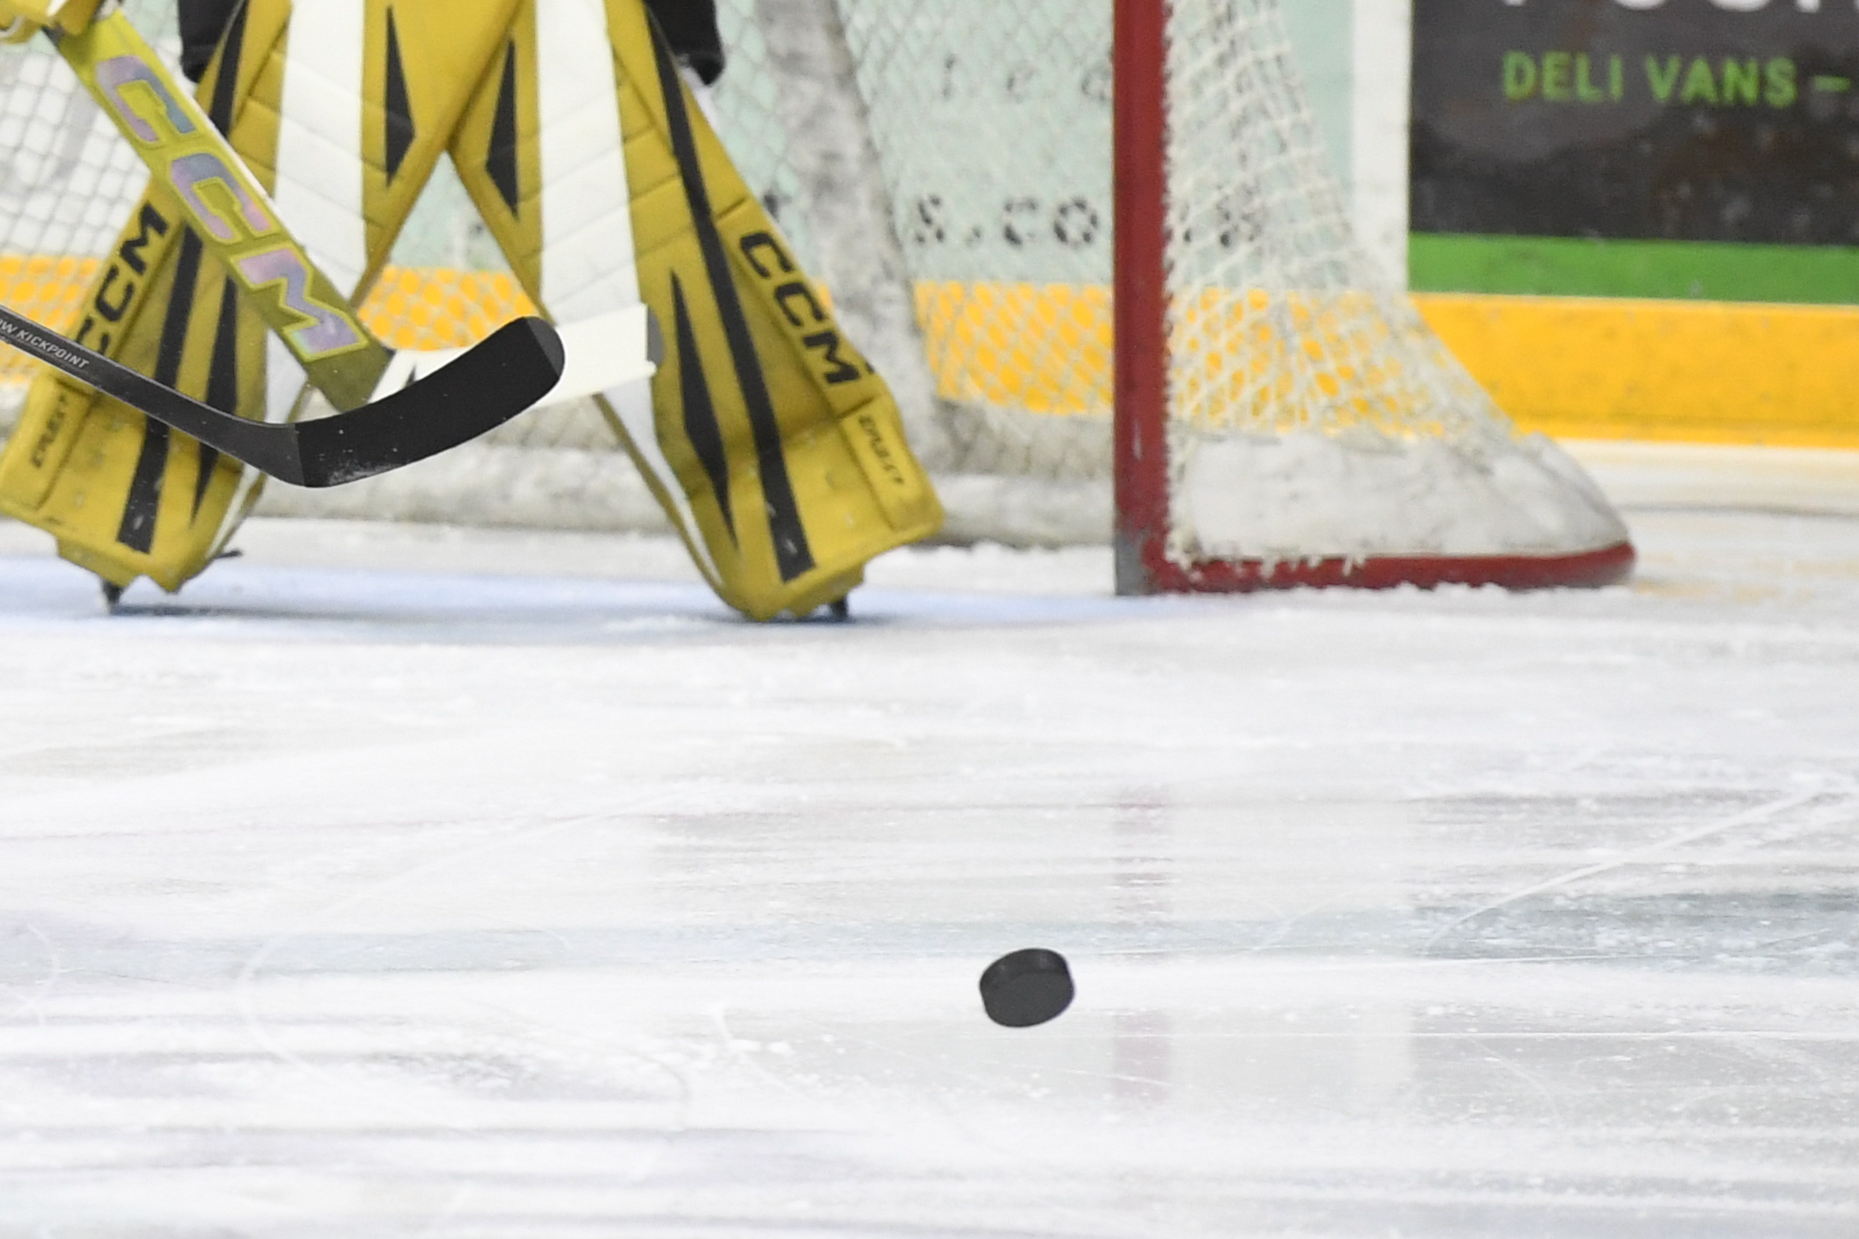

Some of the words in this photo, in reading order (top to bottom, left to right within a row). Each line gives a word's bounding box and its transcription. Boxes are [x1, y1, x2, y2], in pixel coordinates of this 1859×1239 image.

[1502, 50, 1624, 103] DELI
[1644, 56, 1798, 108] VANS
[95, 54, 361, 355] CCM
[16, 329, 90, 370] KICKPOINT
[739, 231, 862, 385] CCM
